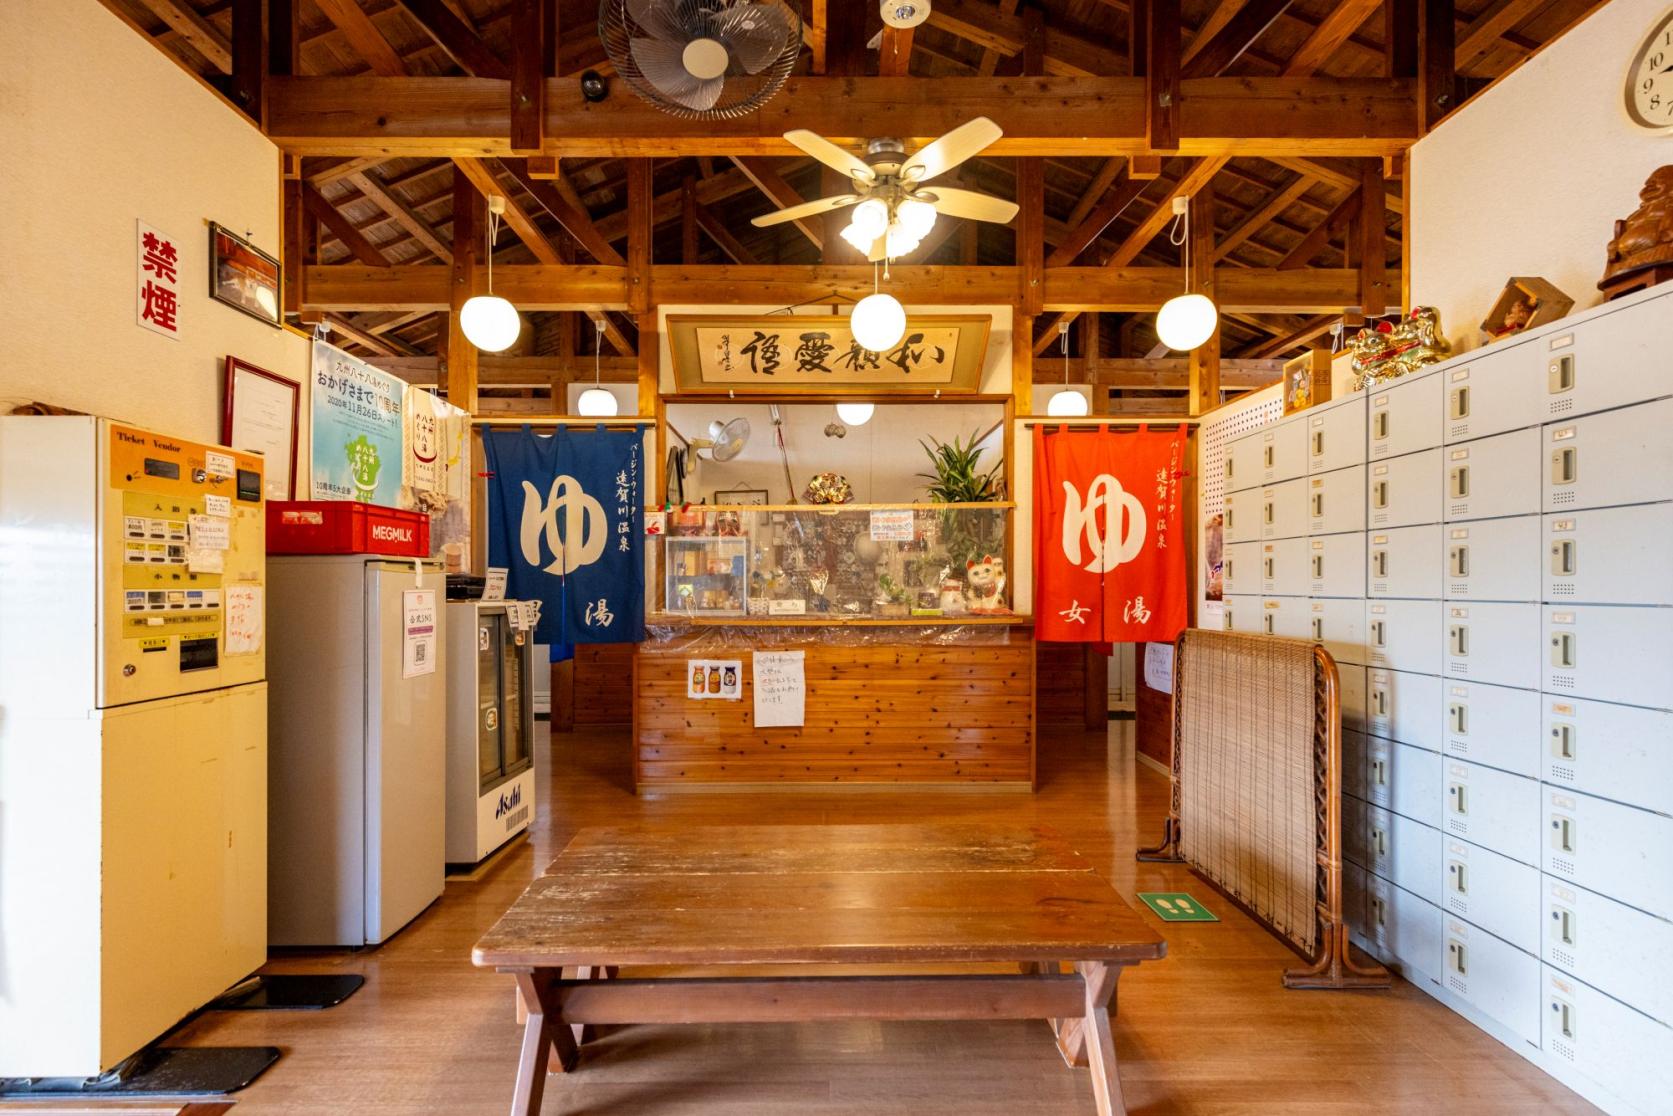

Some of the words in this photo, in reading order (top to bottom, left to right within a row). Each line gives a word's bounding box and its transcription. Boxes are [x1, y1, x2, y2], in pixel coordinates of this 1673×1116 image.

[1649, 52, 1664, 72] 10
[1643, 78, 1654, 94] 9
[1649, 94, 1660, 110] 8
[141, 231, 178, 333] 禁煙
[116, 431, 145, 446] Ticket
[153, 439, 181, 452] Vendor
[616, 469, 631, 553] 遠賀川温泉
[1062, 473, 1147, 574] ゆ
[1155, 466, 1169, 549] 遠賀川温泉
[372, 524, 412, 542] MEGMILK
[520, 474, 609, 576] ゆ
[585, 598, 615, 628] 湯
[495, 783, 521, 820] Asahi
